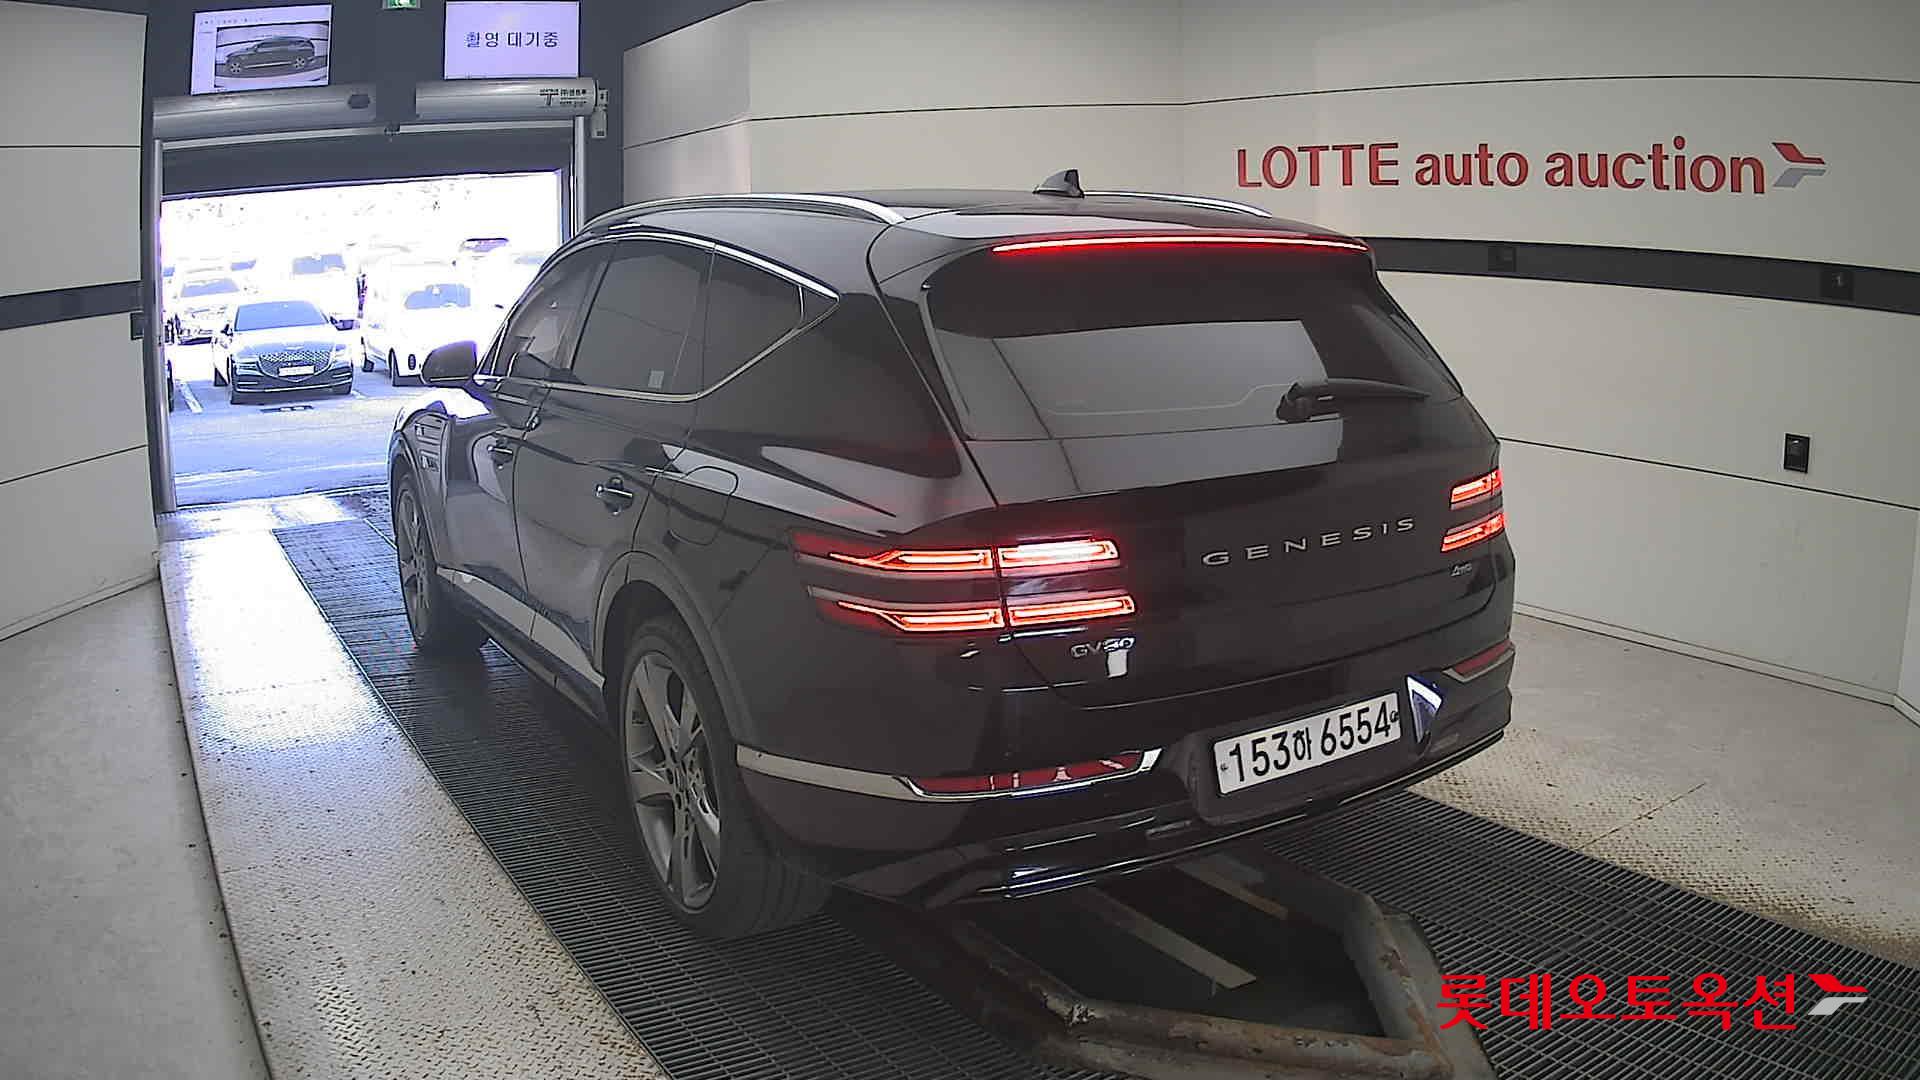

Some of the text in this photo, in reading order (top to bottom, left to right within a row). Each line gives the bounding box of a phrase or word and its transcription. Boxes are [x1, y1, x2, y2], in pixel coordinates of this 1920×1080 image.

[507, 31, 559, 48] 대기중
[1237, 136, 1765, 194] LOTTE auto auction
[1202, 518, 1415, 567] GENESIS
[1229, 701, 1391, 783] 153하 6554
